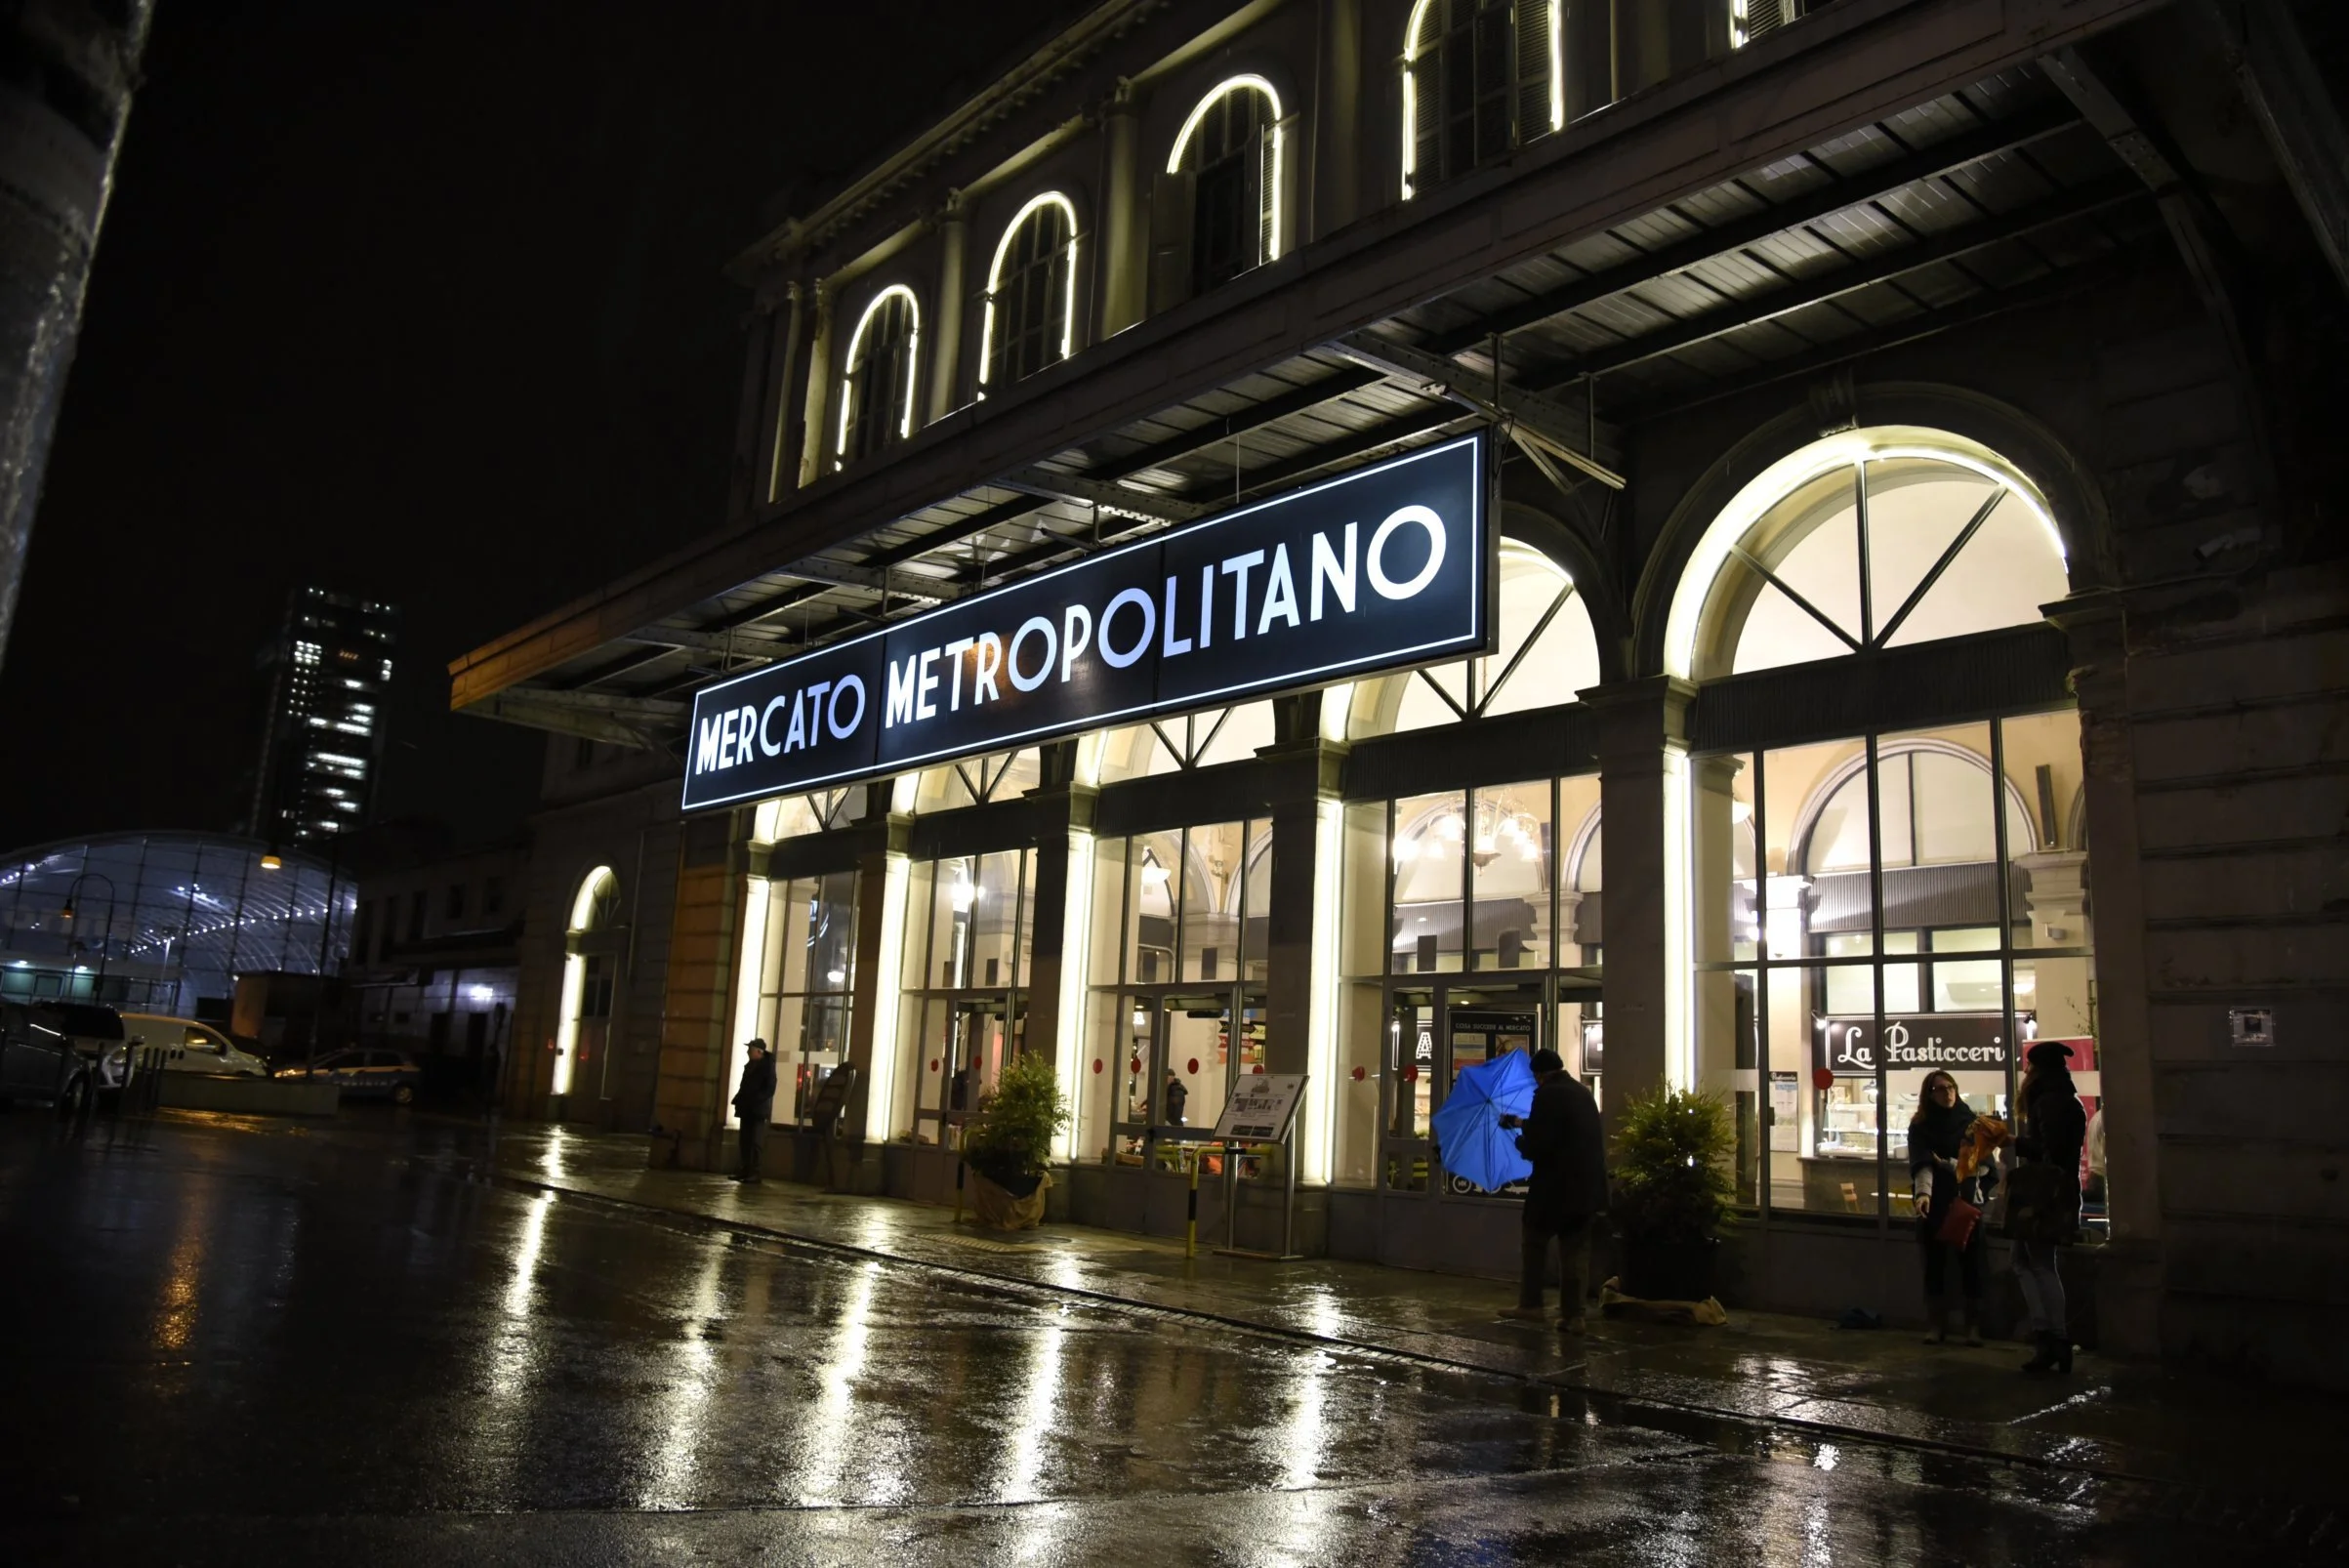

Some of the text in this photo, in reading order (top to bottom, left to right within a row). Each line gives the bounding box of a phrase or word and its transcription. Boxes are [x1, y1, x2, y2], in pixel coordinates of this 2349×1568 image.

[695, 504, 1447, 775] MERCATO METROPOLITANO
[1836, 1025, 1877, 1070] La
